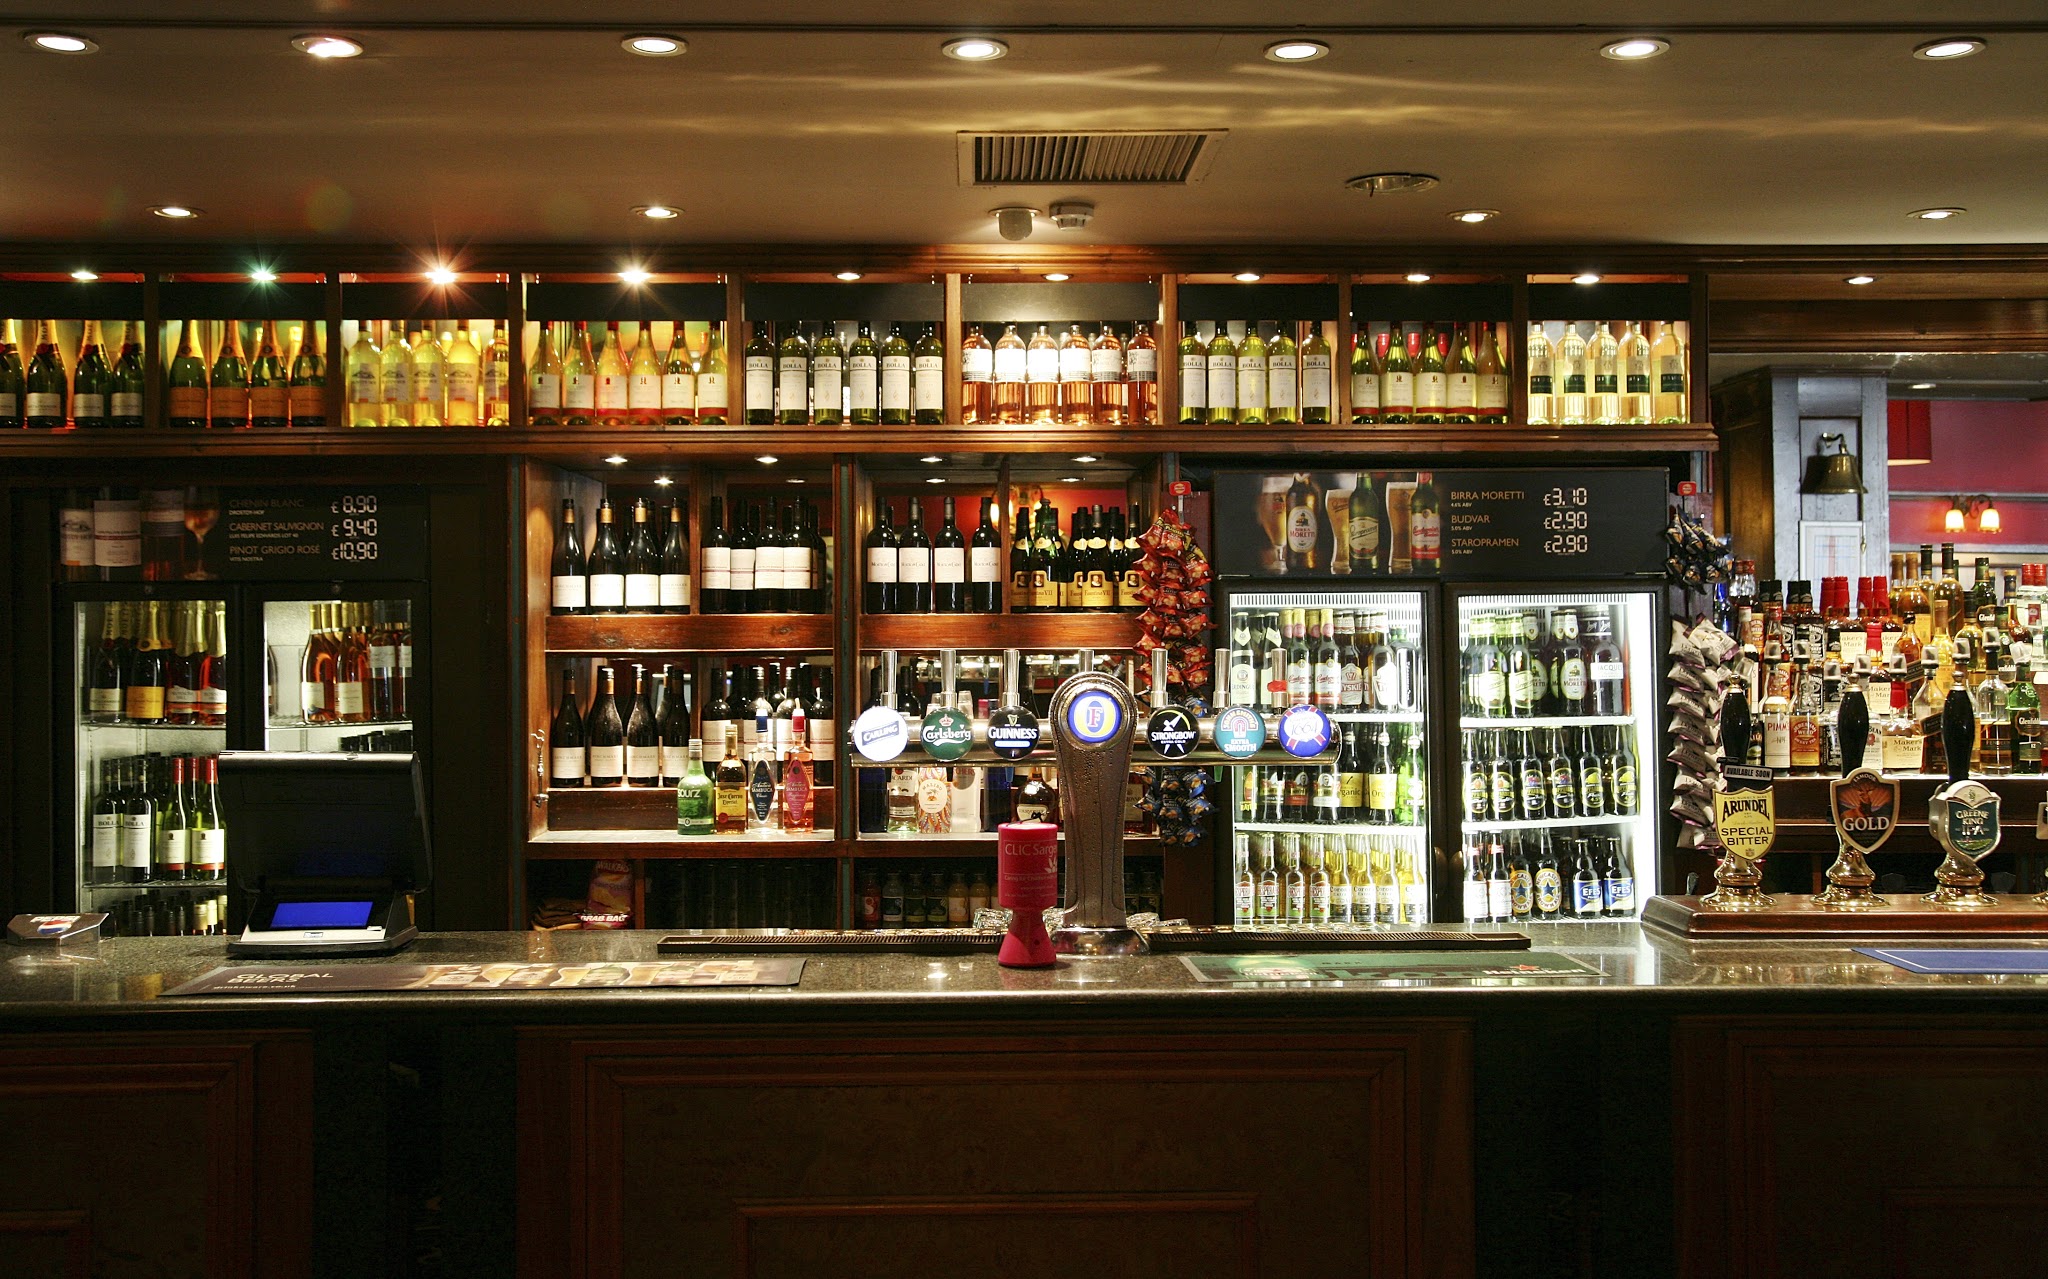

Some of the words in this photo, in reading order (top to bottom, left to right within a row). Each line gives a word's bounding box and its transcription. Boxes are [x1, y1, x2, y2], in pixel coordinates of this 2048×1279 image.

[1451, 492, 1479, 500] BIRRA
[1481, 491, 1525, 500] MORETTI
[270, 499, 304, 508] BLANC
[1451, 515, 1490, 524] BUDVAR
[1544, 512, 1588, 530] £2.90
[228, 522, 272, 532] CABERNET
[273, 522, 324, 531] SAUVIGNON
[1452, 538, 1519, 547] STAROPRAMEN
[1544, 535, 1588, 553] £2.90
[228, 545, 259, 555] PINOT
[260, 545, 295, 554] GRIGIO
[331, 542, 378, 560] £10.90
[862, 724, 899, 742] CARLING
[922, 724, 971, 743] Carlsberg
[988, 726, 1038, 740] GUINNESS
[1152, 731, 1195, 741] STRONGBOW
[1224, 744, 1256, 752] SMOOTH
[1726, 768, 1754, 777] AVAILABLE
[1755, 770, 1771, 778] SOON
[1853, 774, 1876, 782] EXMOOR
[1722, 799, 1770, 823] ARUNDEL
[1955, 810, 1990, 820] GREENE
[1842, 816, 1890, 831] GOLD
[1721, 826, 1773, 836] SPECIAL
[1962, 826, 1984, 836] IPA
[1727, 836, 1768, 846] BITTER
[1005, 844, 1032, 856] CLIC
[1536, 872, 1560, 885] NEWCASTLE
[1582, 888, 1600, 896] EFES
[1612, 886, 1630, 894] EFES
